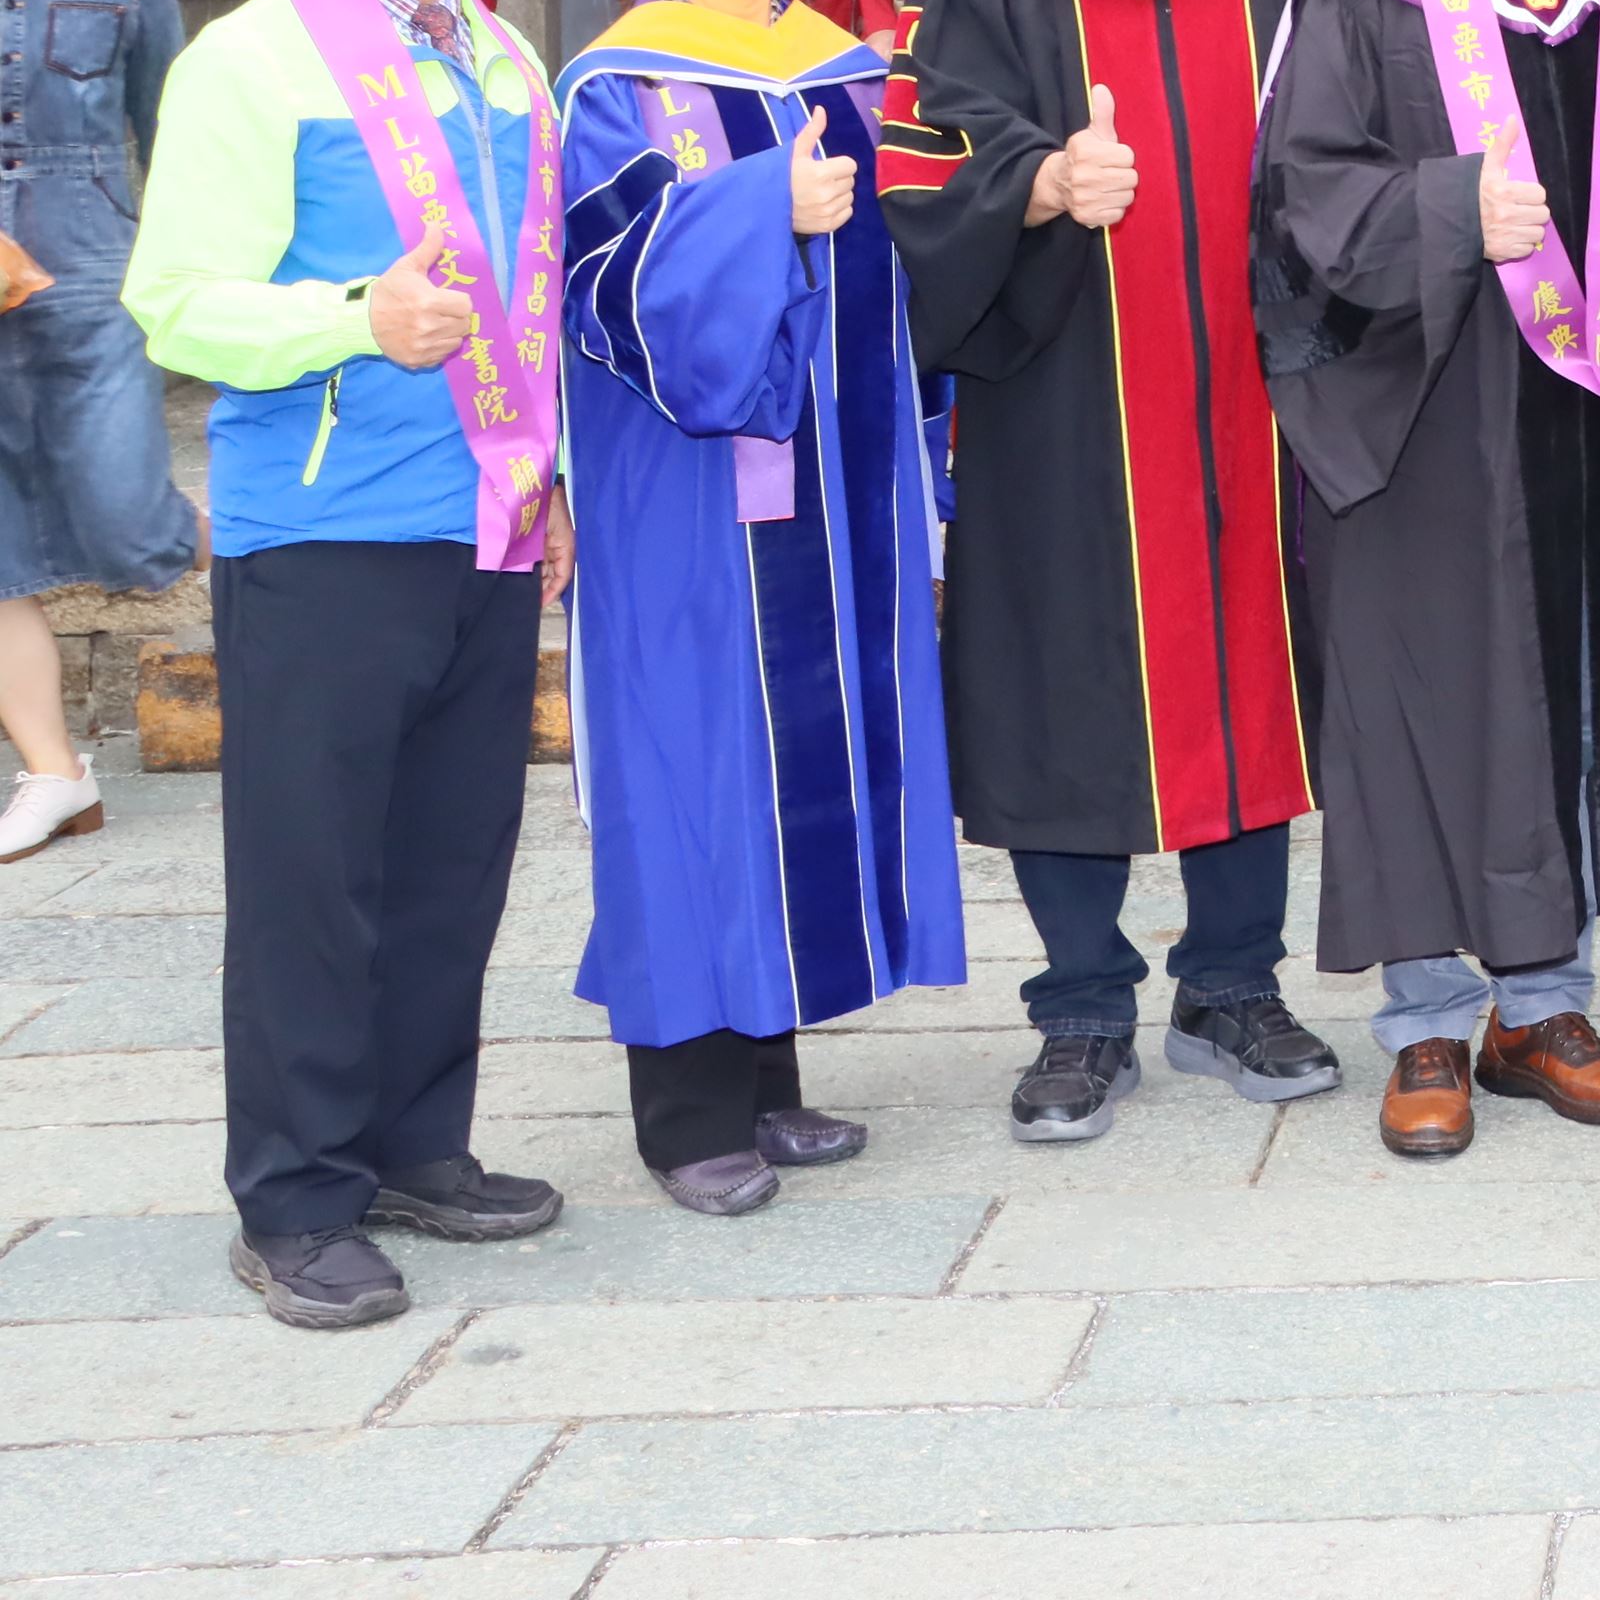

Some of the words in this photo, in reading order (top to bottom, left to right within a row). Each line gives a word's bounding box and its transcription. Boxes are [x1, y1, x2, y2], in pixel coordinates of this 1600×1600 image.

[646, 74, 708, 172] L苗
[357, 63, 518, 430] ML苗栗文書院
[1532, 279, 1580, 361] 慶典
